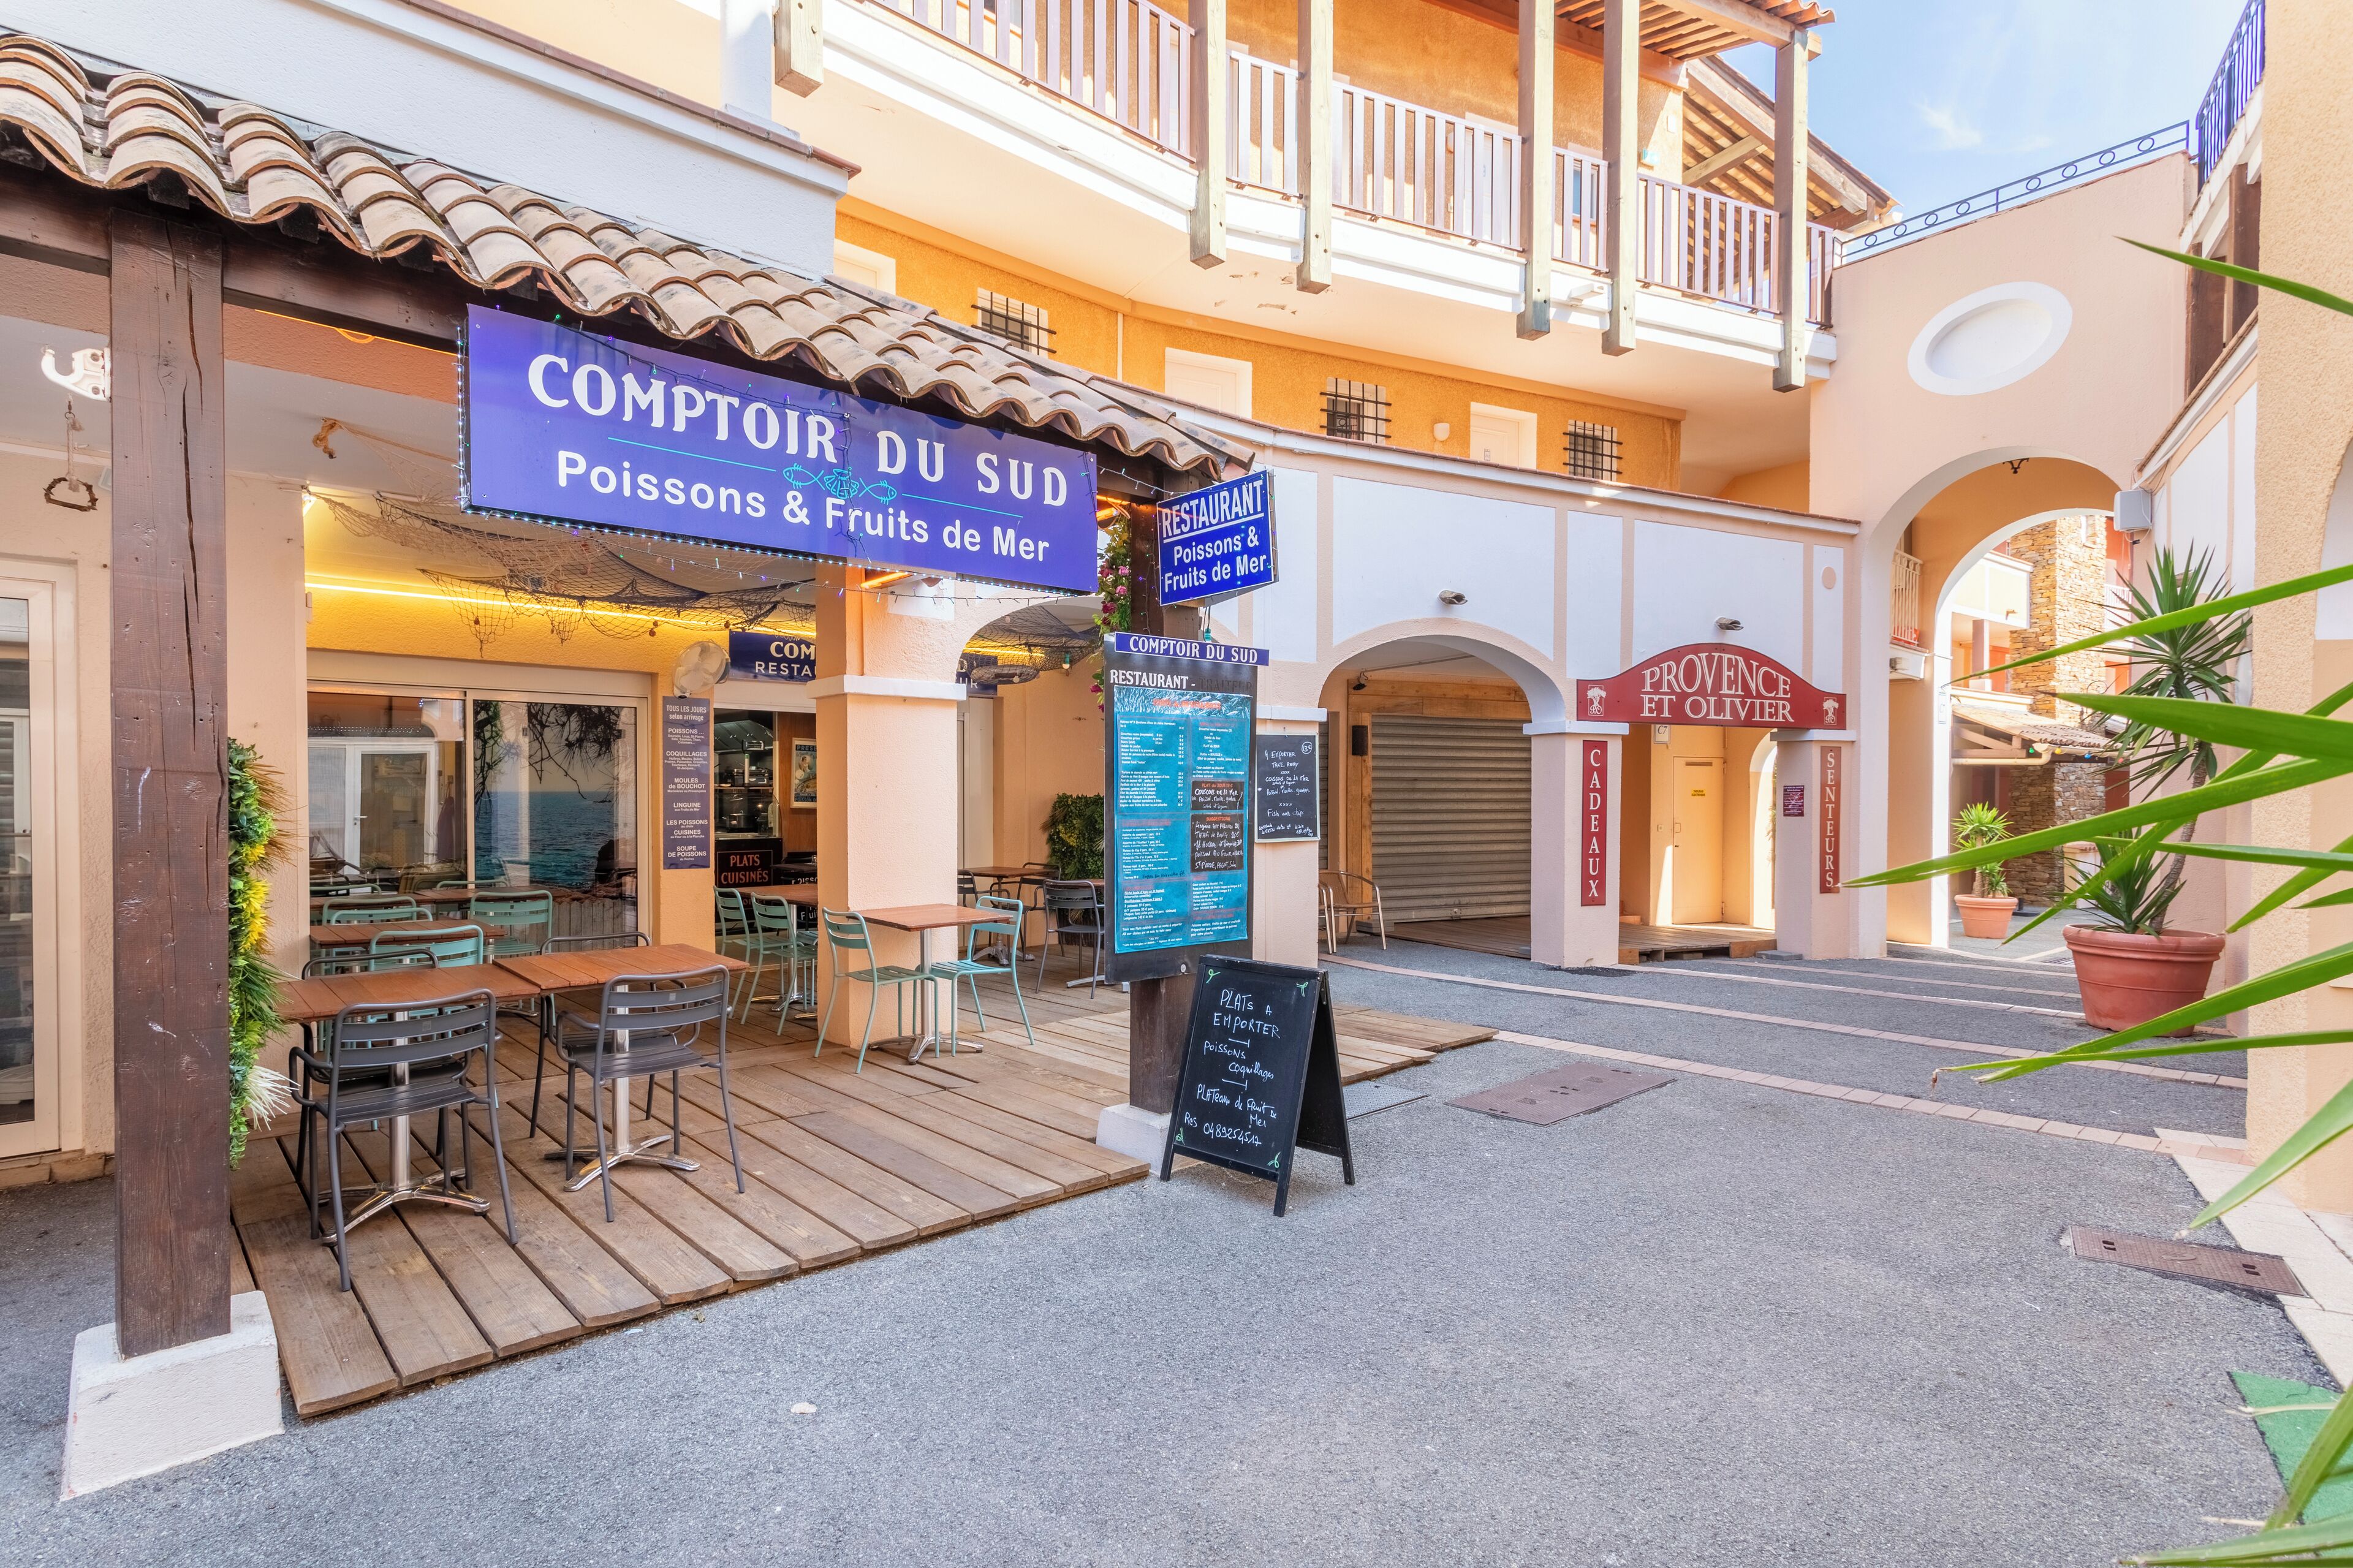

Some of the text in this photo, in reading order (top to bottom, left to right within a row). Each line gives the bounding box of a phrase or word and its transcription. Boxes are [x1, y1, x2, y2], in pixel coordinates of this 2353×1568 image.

[528, 354, 1067, 507] COMPTOIR DU SUD
[558, 450, 1049, 561] Poissons & Fruits de Mer
[1162, 479, 1263, 538] RESTAURANT
[1174, 526, 1259, 566] Poissons &
[1164, 555, 1266, 593] Fruits de Mer
[770, 642, 816, 660] COM
[1129, 636, 1257, 664] COMPTOIR DU SUD
[756, 661, 816, 676] RESTA
[1110, 670, 1188, 689] RESTAURANT
[1642, 653, 1790, 698] PROVENCE
[1640, 694, 1794, 722] ET OLIVIER
[1658, 725, 1668, 735] C7
[1271, 751, 1296, 760] EMPORTER
[1588, 749, 1601, 897] CADEAUX
[1825, 752, 1835, 888] SENTEURS
[730, 854, 760, 867] PLATS
[721, 868, 768, 885] CUISINÉS
[1265, 1005, 1272, 1016] A
[1214, 1012, 1280, 1039] EMPORTER
